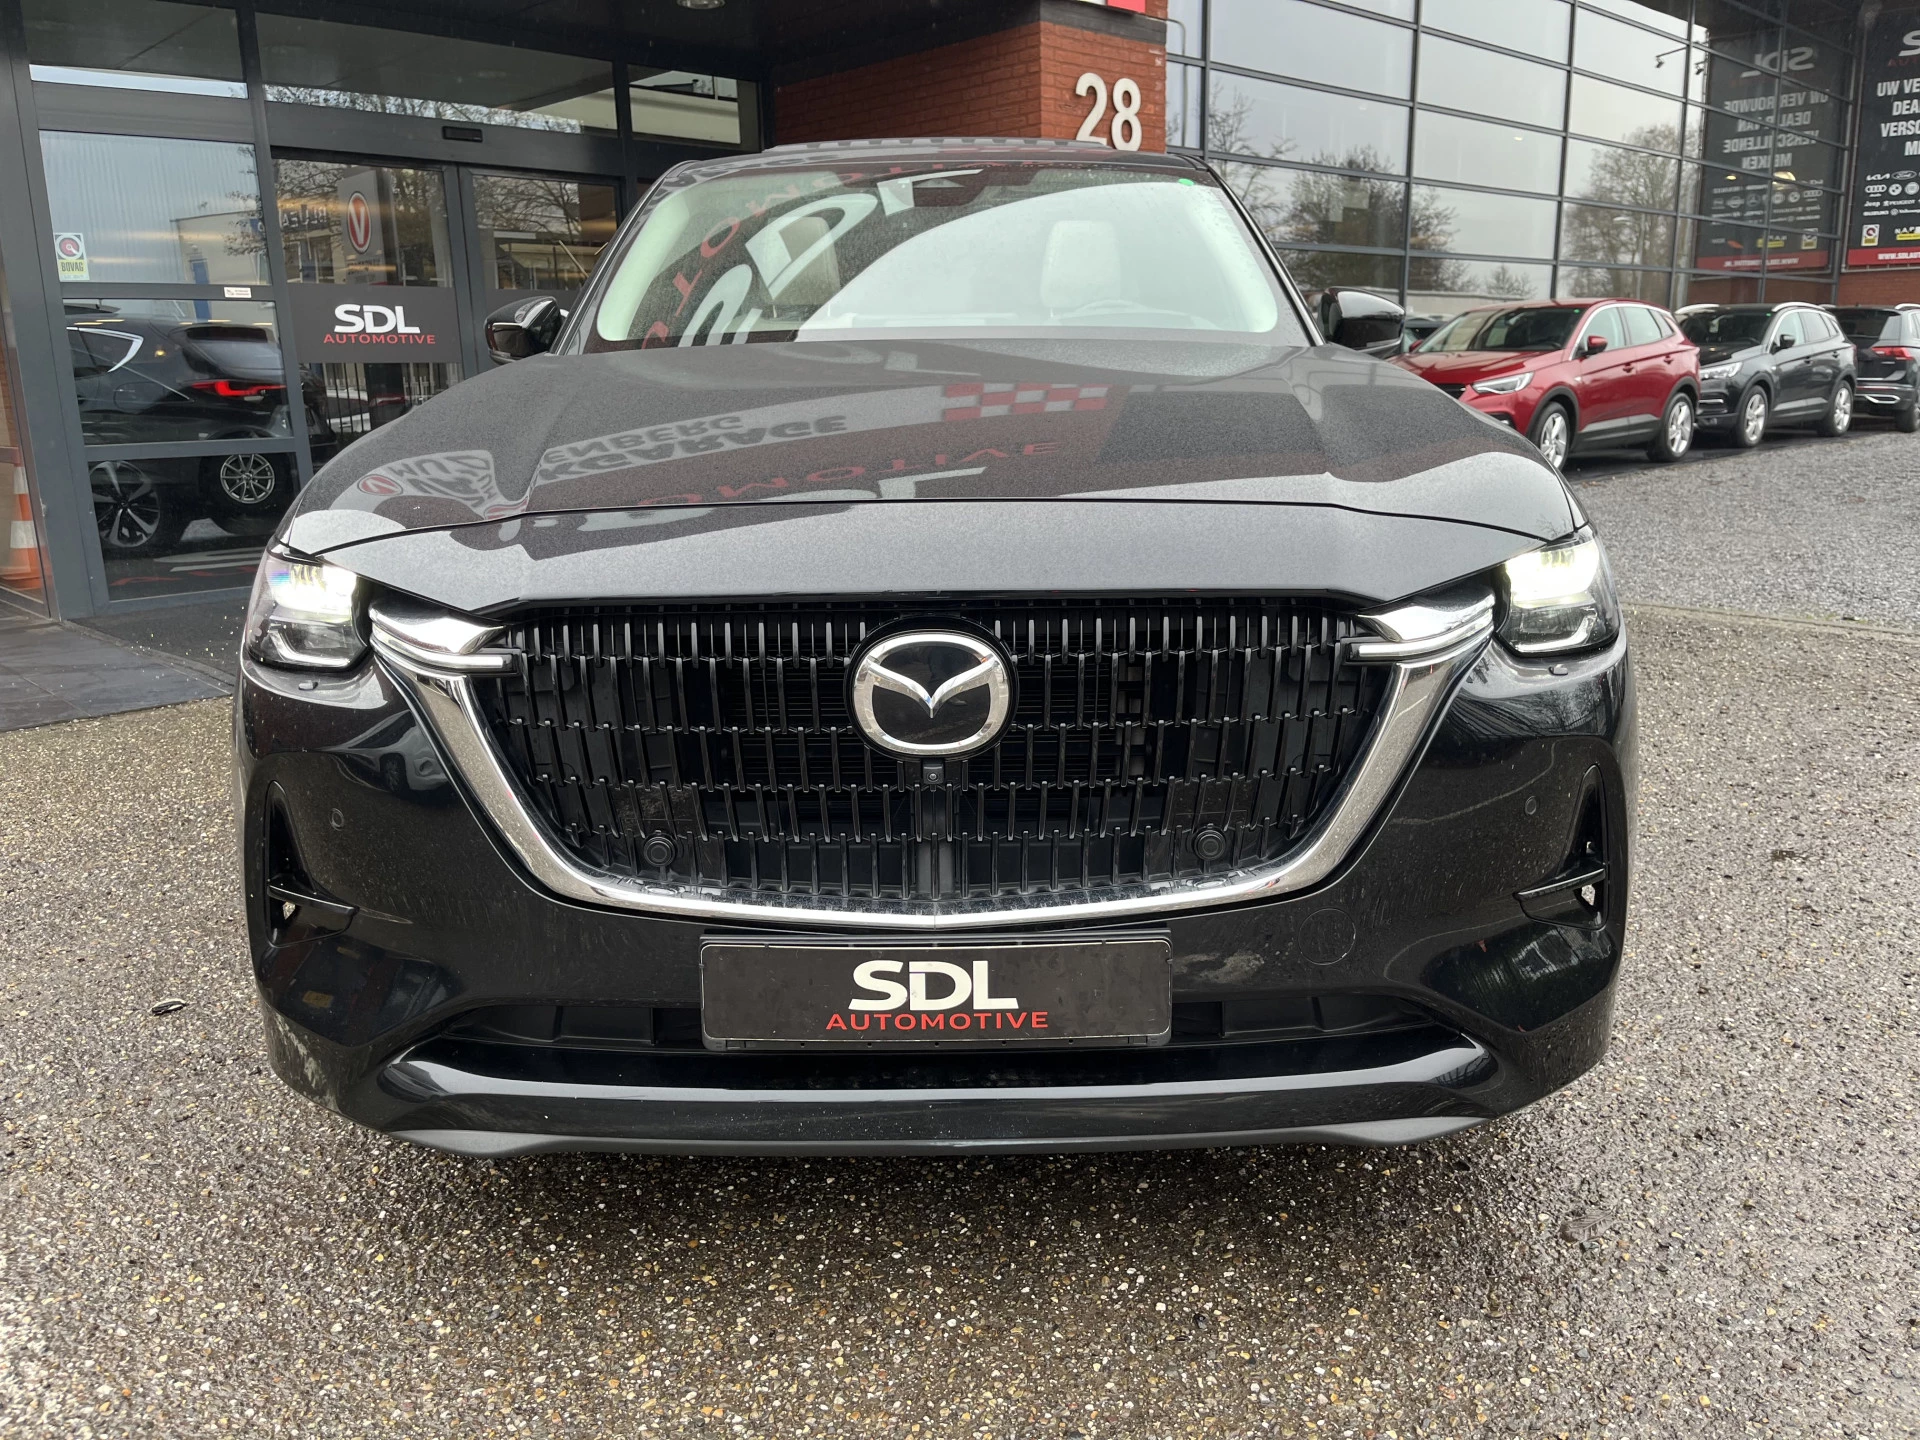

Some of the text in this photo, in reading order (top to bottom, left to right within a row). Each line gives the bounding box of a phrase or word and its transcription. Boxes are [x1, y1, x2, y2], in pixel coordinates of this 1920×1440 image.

[1877, 80, 1900, 97] UW
[1075, 72, 1142, 151] 28
[1892, 99, 1920, 116] DEA
[61, 261, 84, 272] BOVAG
[334, 303, 421, 333] SDL
[323, 334, 436, 344] AUTOMOTIVE
[847, 959, 1020, 1011] SDL
[826, 1011, 1048, 1031] AUTOMOTIVE
